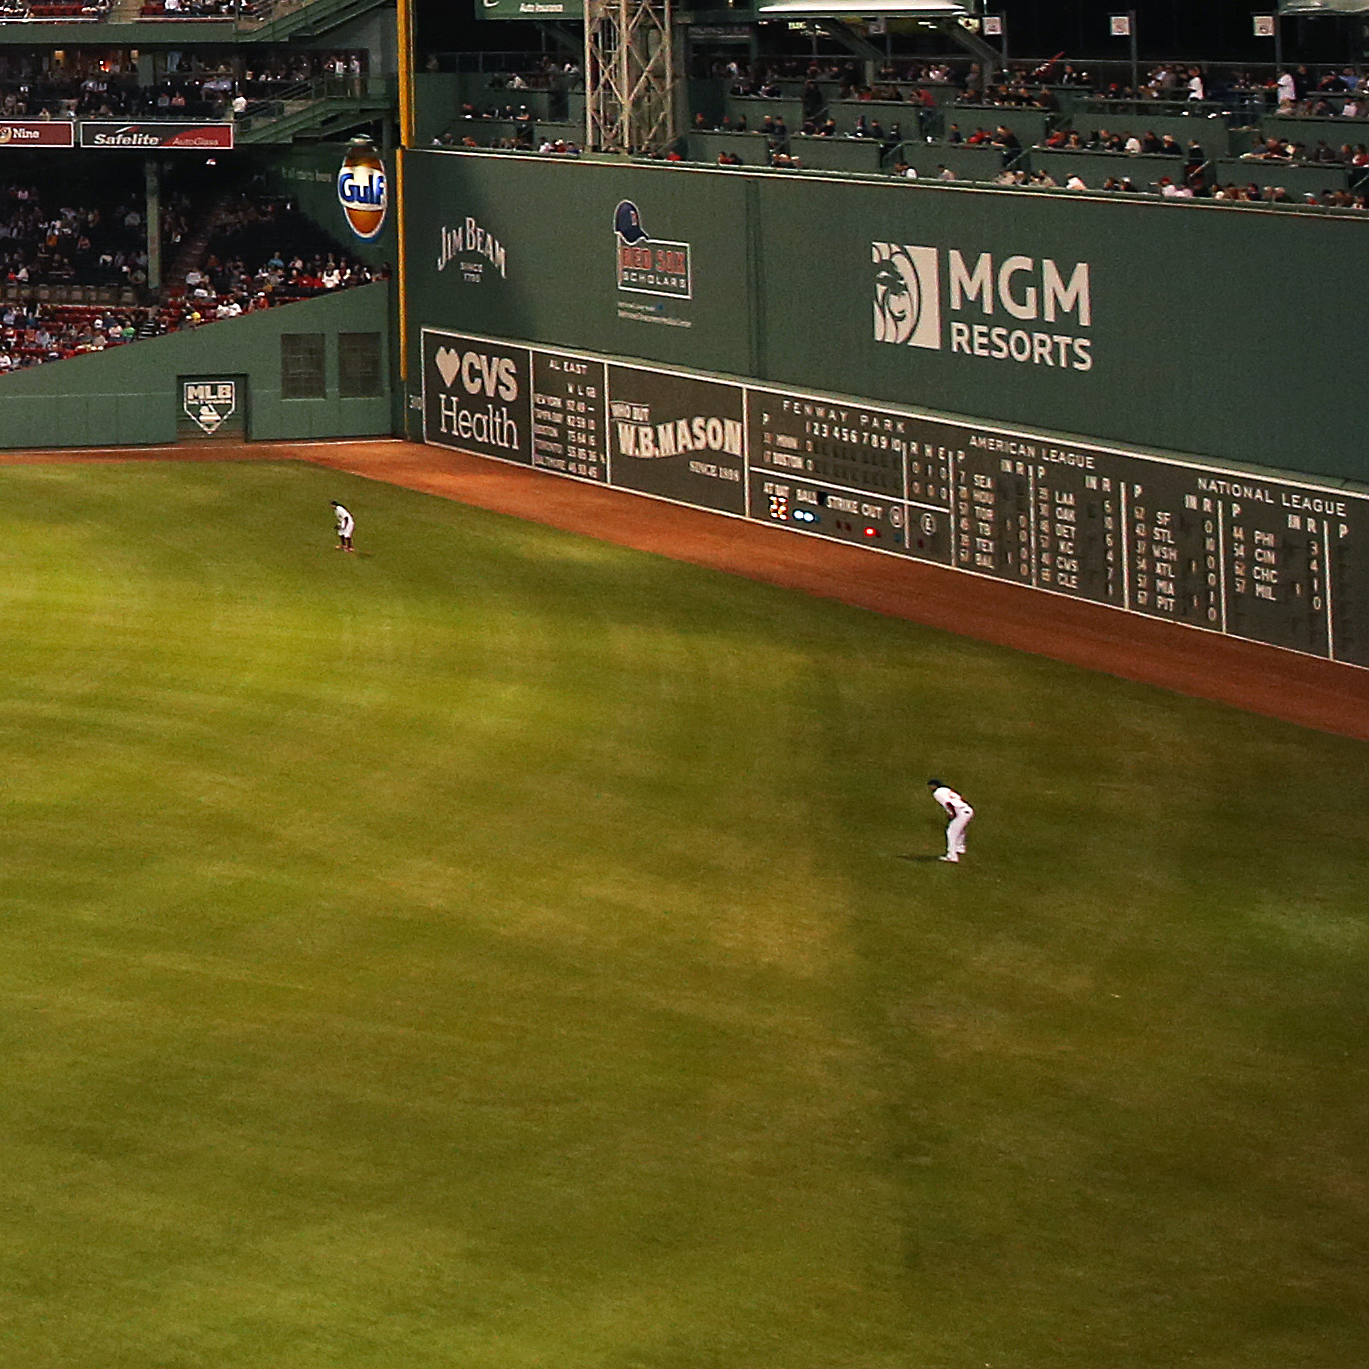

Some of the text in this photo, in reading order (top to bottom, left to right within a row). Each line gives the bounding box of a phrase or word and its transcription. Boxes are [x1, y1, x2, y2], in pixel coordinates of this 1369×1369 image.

[12, 127, 40, 139] Nine
[94, 133, 159, 146] Safelite
[340, 173, 385, 205] Gulf
[437, 217, 506, 280] JIM BEAM
[622, 245, 686, 275] RED SOX
[622, 270, 687, 288] SCHOLARS
[948, 249, 1092, 327] MGM
[950, 321, 1093, 372] RESORTS
[461, 351, 518, 402] CVS
[548, 359, 588, 375] AL EAST
[187, 385, 232, 400] MLB
[439, 393, 519, 451] Health
[783, 399, 906, 434] FENWAY PARK
[805, 420, 947, 461] 1 2 3 4 5 6 7 8 9 10 R E
[968, 435, 1095, 470] AMERICAN LEAGUE
[689, 460, 718, 478] SINCE
[957, 450, 966, 463] P
[1037, 465, 1047, 479] P
[795, 488, 819, 505] BALL
[826, 494, 860, 515] STRIKE
[861, 503, 884, 520] OUT
[1133, 484, 1212, 513] P R
[1198, 477, 1347, 518] NATIONAL LEAGUE
[1156, 511, 1213, 534] SF 0
[1231, 502, 1317, 534] P R
[1338, 523, 1349, 539] P
[1153, 526, 1175, 545] STL
[1253, 530, 1275, 548] PHI
[1310, 540, 1319, 556] 3
[1152, 544, 1216, 569] WSH 0
[1254, 548, 1319, 572] CIN 4
[1107, 566, 1114, 580] 7
[1207, 572, 1216, 587] 0
[1253, 566, 1318, 592] CHC 1
[1156, 595, 1217, 621] PIT 0
[1255, 583, 1322, 611] MIL 0
